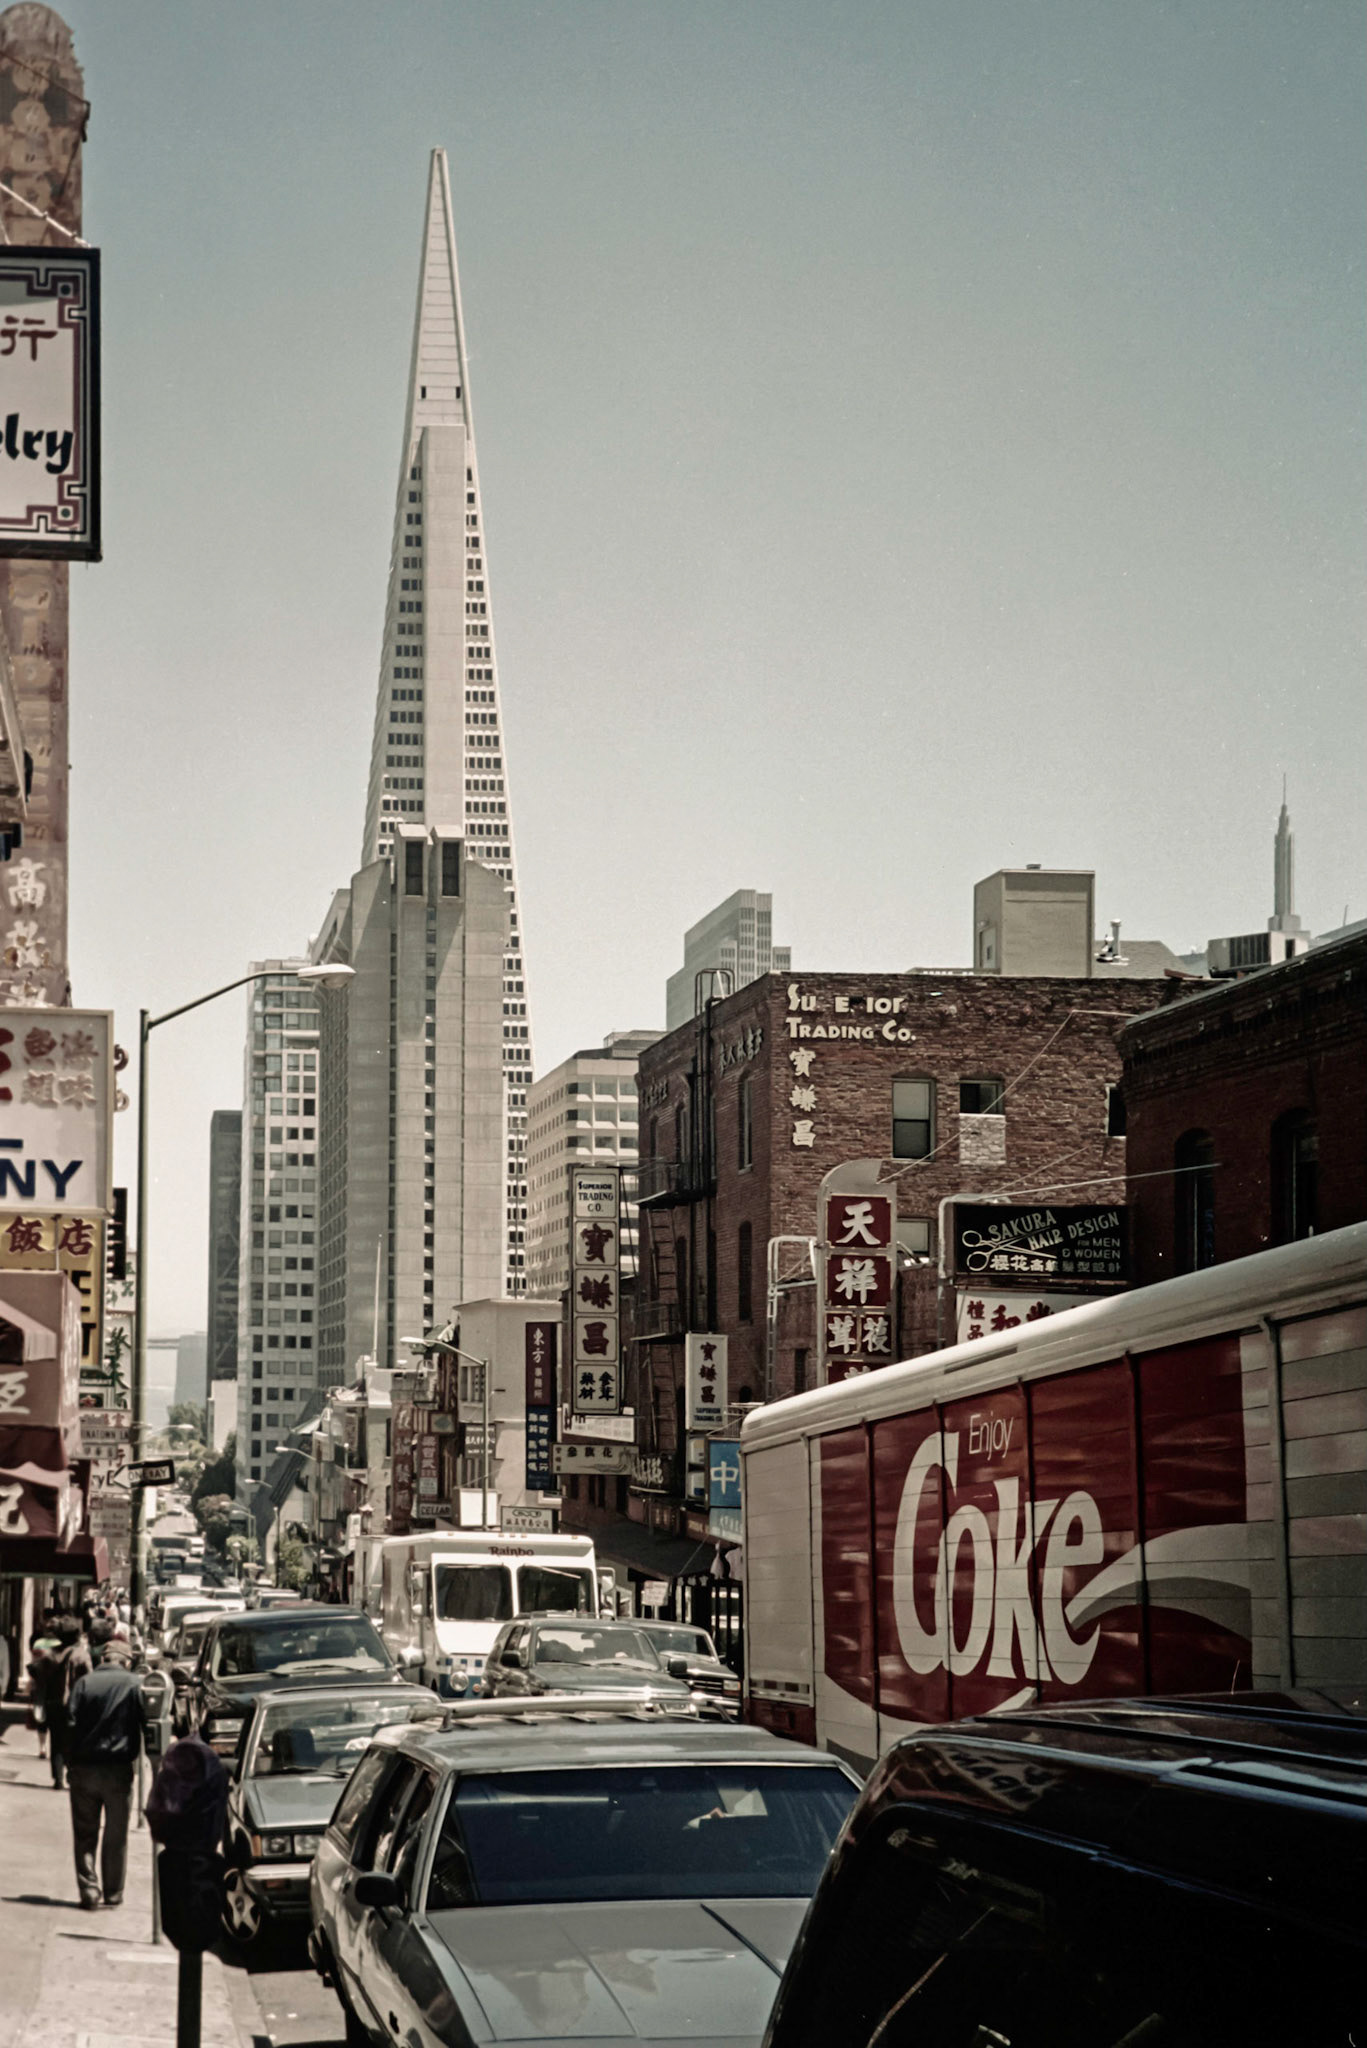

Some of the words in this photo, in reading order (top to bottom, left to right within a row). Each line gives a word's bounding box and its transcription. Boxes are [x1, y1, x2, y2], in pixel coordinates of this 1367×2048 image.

[0, 413, 74, 474] lry
[578, 1192, 613, 1200] TRADING
[587, 1203, 604, 1212] CO.
[5, 1216, 94, 1256] 飯店
[988, 1210, 1056, 1242] SAKURA
[1028, 1229, 1064, 1250] HAIR
[1067, 1212, 1119, 1239] DESIGN
[1075, 1249, 1120, 1259] WOMEN
[1093, 1238, 1120, 1247] MEN
[968, 1410, 1014, 1461] Enjoy
[489, 1546, 535, 1556] Rainbo
[893, 1432, 1104, 1685] Coke
